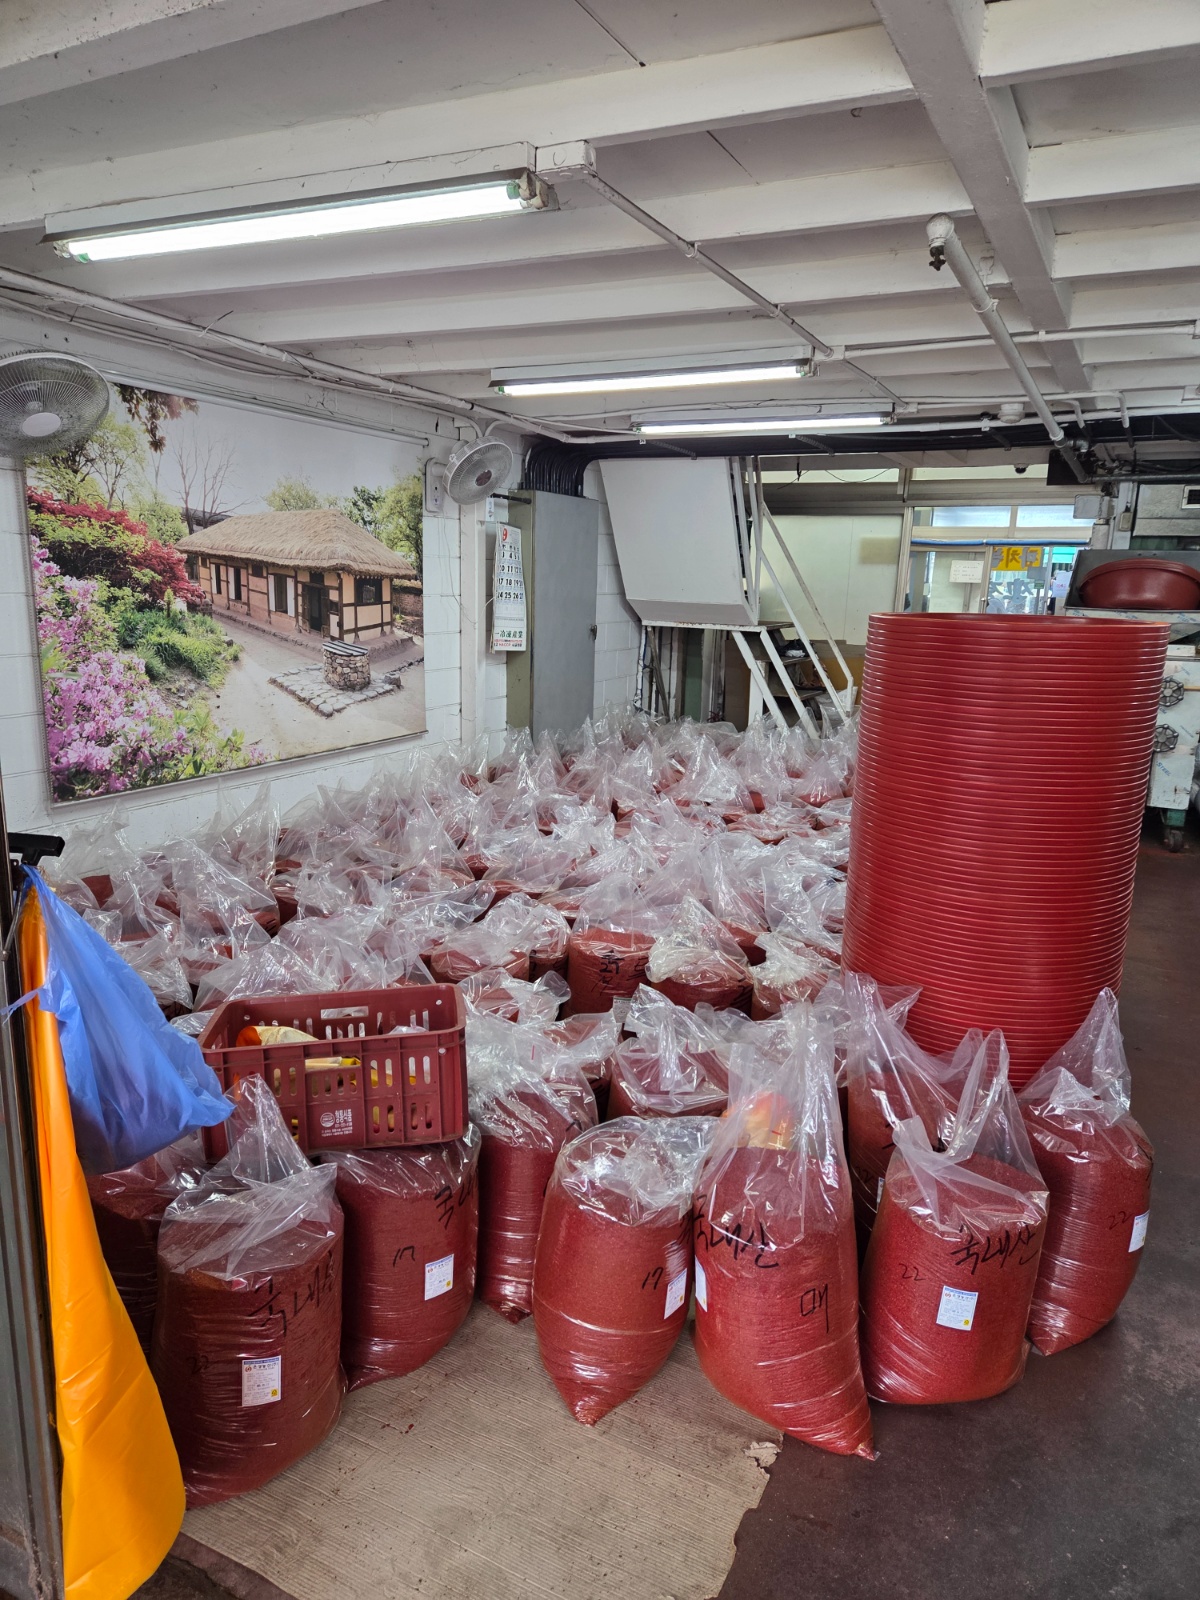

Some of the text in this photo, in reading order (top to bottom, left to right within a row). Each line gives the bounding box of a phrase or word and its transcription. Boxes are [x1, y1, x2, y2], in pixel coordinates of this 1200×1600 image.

[503, 528, 508, 541] 9
[506, 578, 512, 586] 18
[504, 591, 512, 599] 25
[513, 592, 519, 600] 26
[1107, 1211, 1135, 1230] 22
[951, 1222, 1039, 1275] 국내산
[642, 1266, 664, 1290] 17
[899, 1263, 926, 1281] 22
